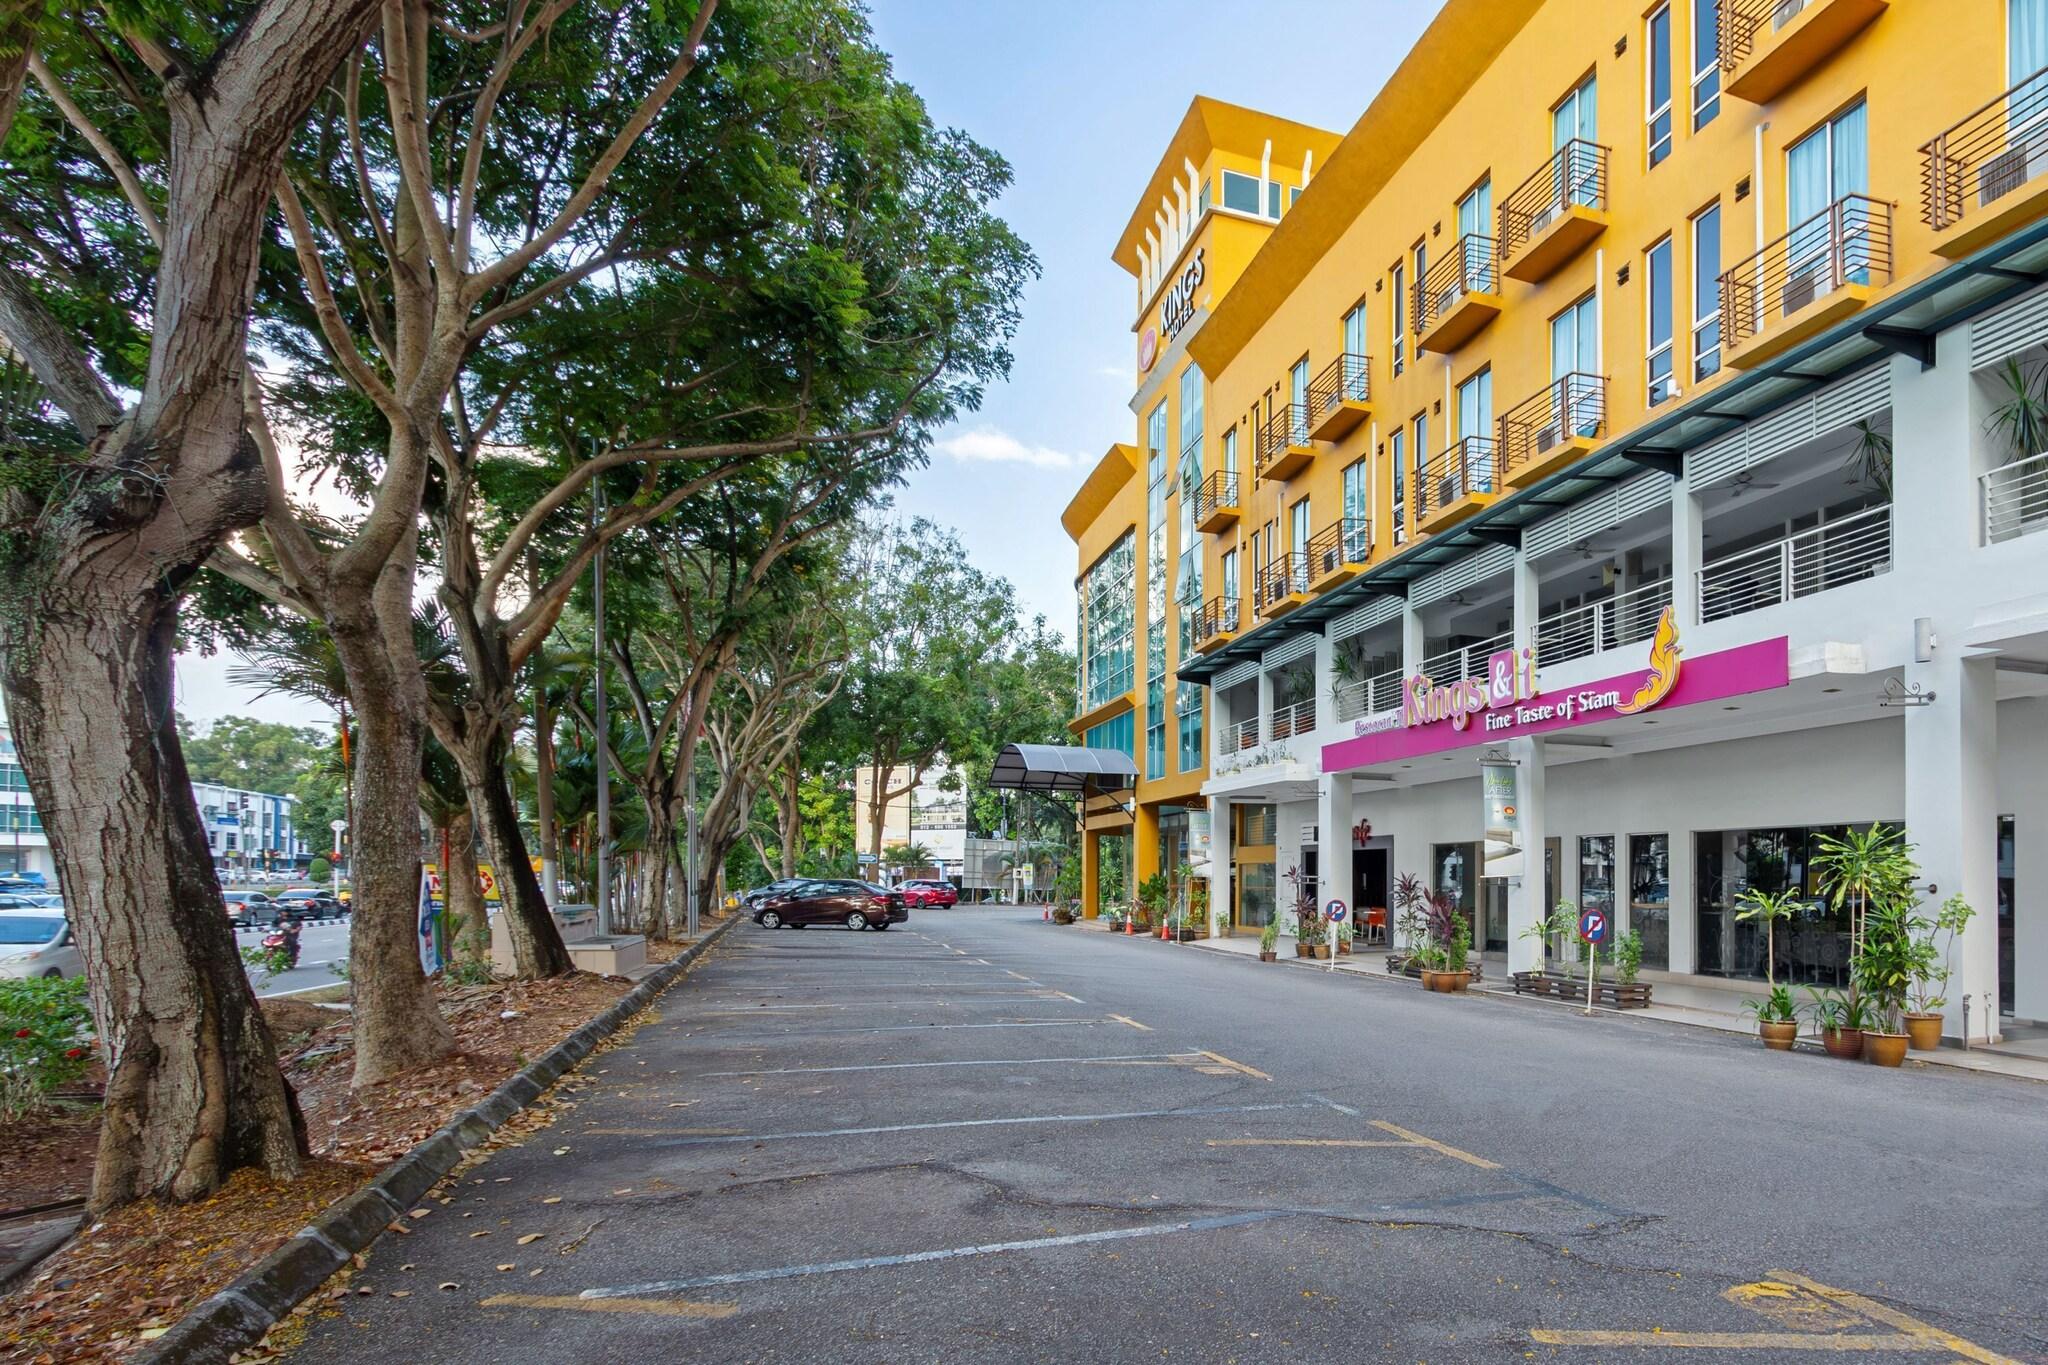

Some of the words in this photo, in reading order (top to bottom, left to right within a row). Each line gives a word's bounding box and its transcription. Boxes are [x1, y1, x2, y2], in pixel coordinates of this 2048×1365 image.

[1161, 248, 1204, 336] KINGS
[1169, 300, 1196, 342] HOTEL
[1401, 675, 1487, 731] Kings
[1523, 648, 1539, 700] i
[1486, 713, 1512, 731] Fine
[1515, 705, 1554, 725] Taste
[1557, 695, 1576, 720] of
[1579, 690, 1618, 712] Siam
[1587, 915, 1603, 939] P
